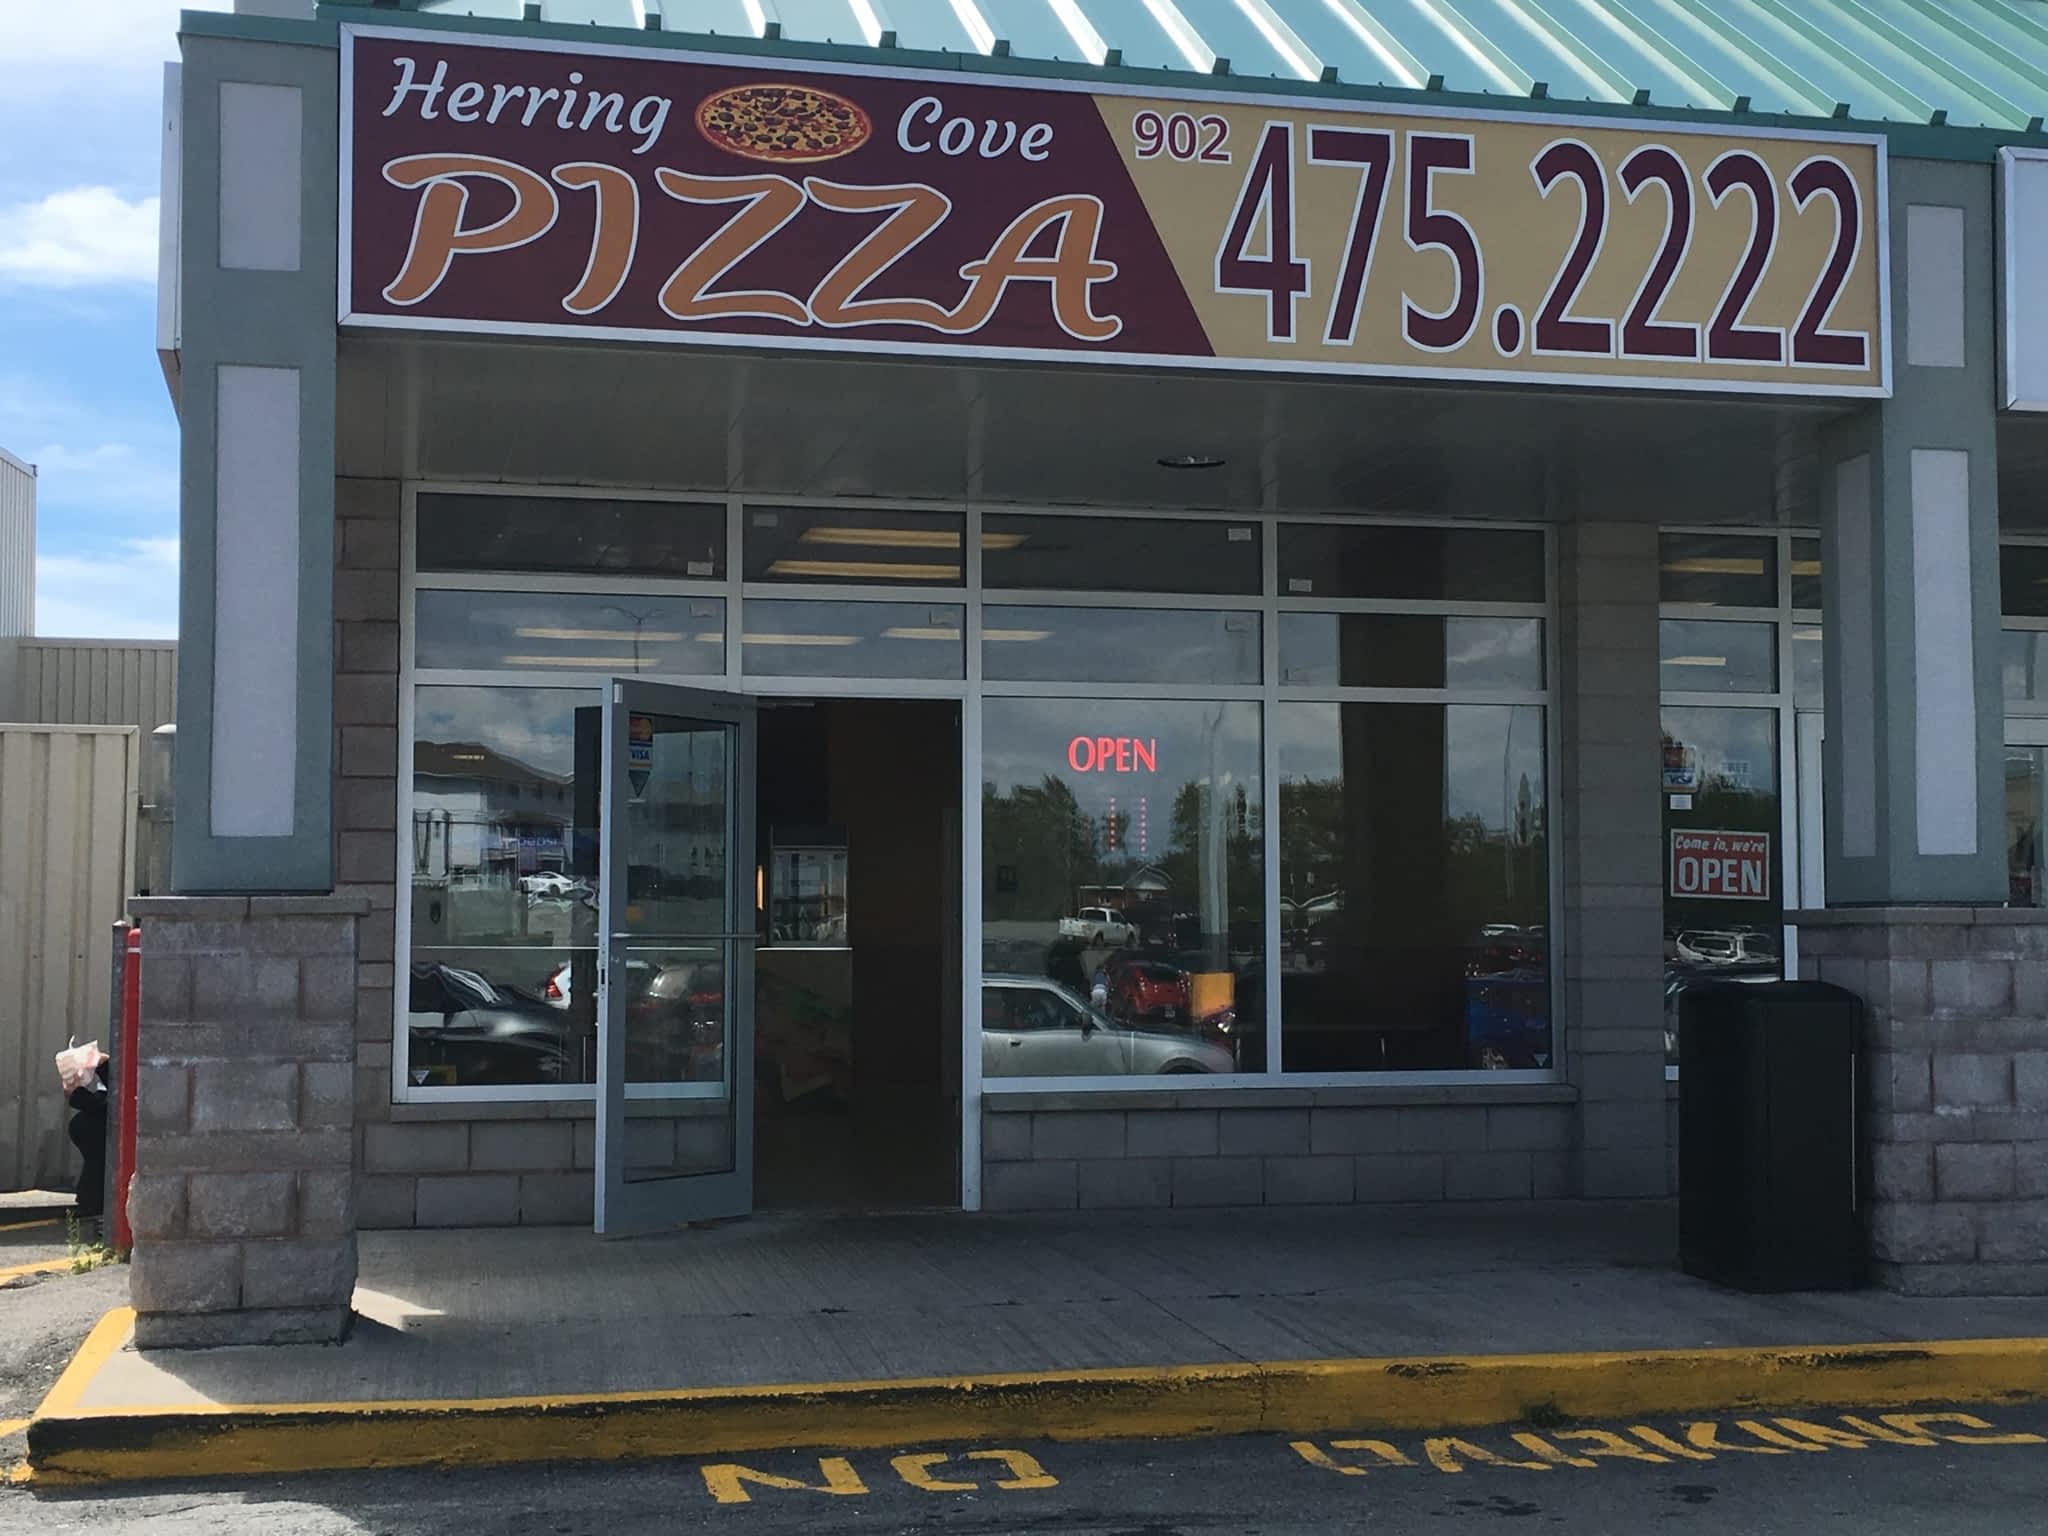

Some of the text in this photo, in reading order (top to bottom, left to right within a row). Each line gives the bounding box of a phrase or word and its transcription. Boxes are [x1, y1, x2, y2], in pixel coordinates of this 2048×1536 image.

[382, 57, 1054, 162] Herring Cove
[381, 152, 1124, 342] PIZZA
[1131, 109, 1871, 372] 902 475.2222
[1066, 735, 1158, 773] OPEN
[1675, 836, 1709, 850] Come
[1678, 856, 1762, 894] OPEN
[701, 1412, 2047, 1503] NO PARKING
